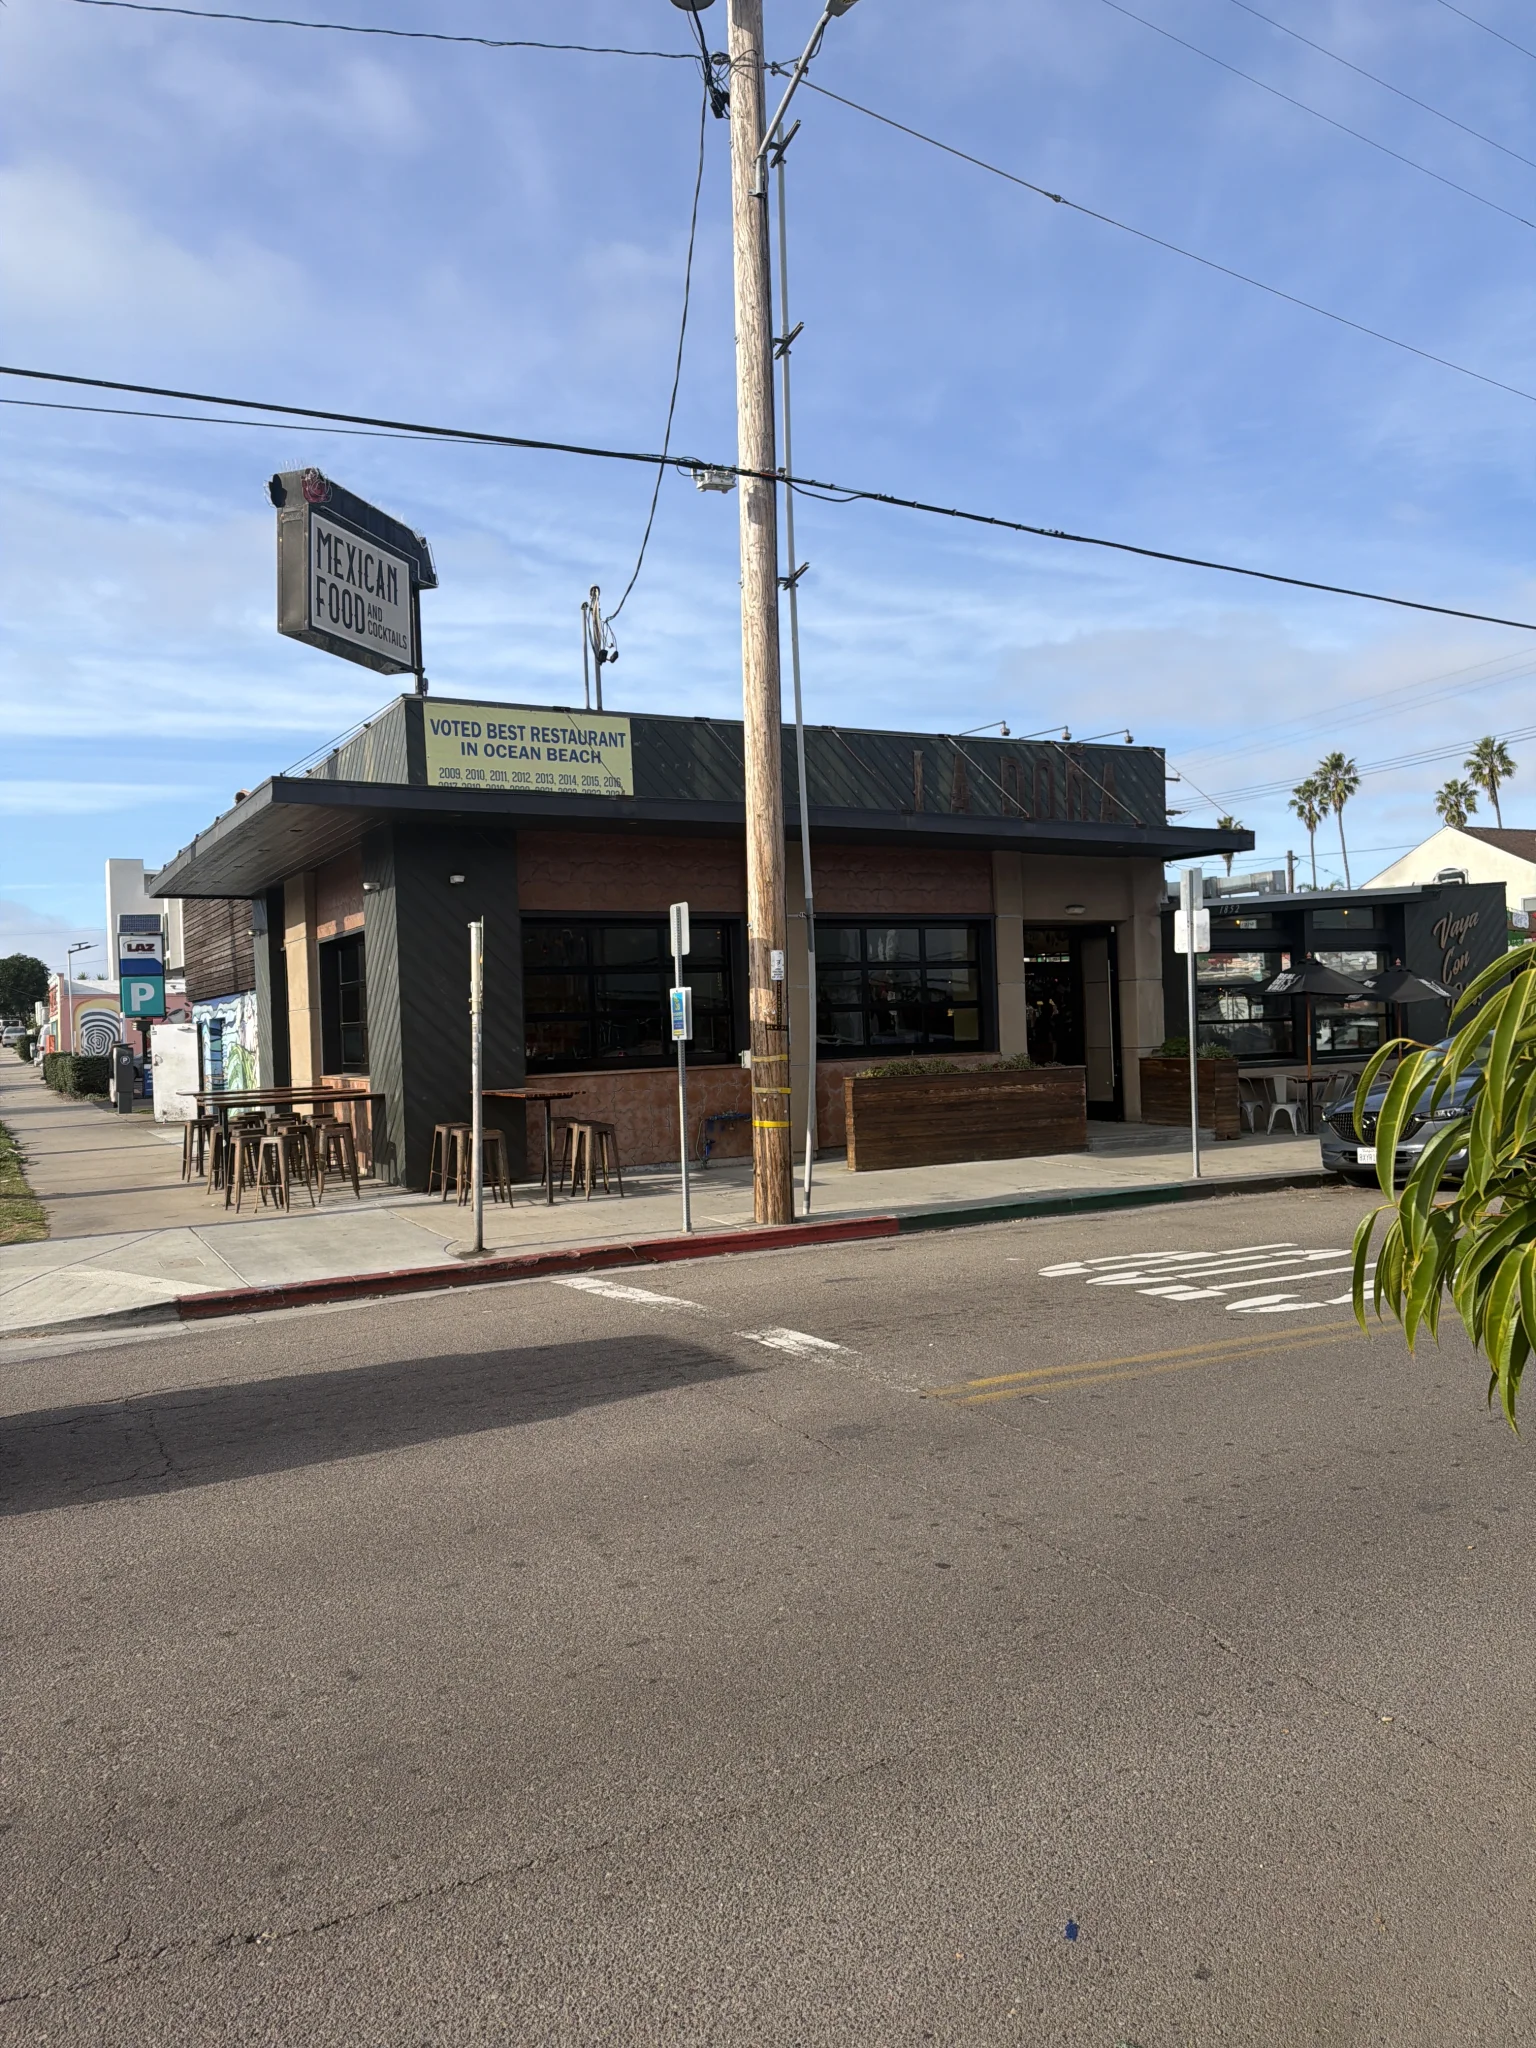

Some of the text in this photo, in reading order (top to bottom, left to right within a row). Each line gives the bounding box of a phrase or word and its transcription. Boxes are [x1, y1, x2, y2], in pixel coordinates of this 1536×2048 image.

[316, 527, 399, 606] MEXICAN
[316, 575, 365, 635] FOOD
[367, 603, 383, 622] AND
[367, 620, 407, 650] COCKTAILS
[430, 719, 626, 748] VOTED BEST RESTAURANT
[461, 742, 602, 764] IN OCEAN BEACH
[439, 767, 463, 781] 2009,
[466, 769, 487, 782] 2010,
[490, 770, 510, 783] 2011,
[512, 771, 533, 784] 2012,
[536, 773, 556, 786] 2013,
[558, 774, 579, 786] 2014,
[581, 775, 602, 787] 2015,
[1220, 905, 1240, 914] 1852
[1433, 911, 1479, 949] Vaya
[127, 943, 155, 952] LAZ
[1443, 946, 1470, 985] Con
[130, 982, 155, 1012] P
